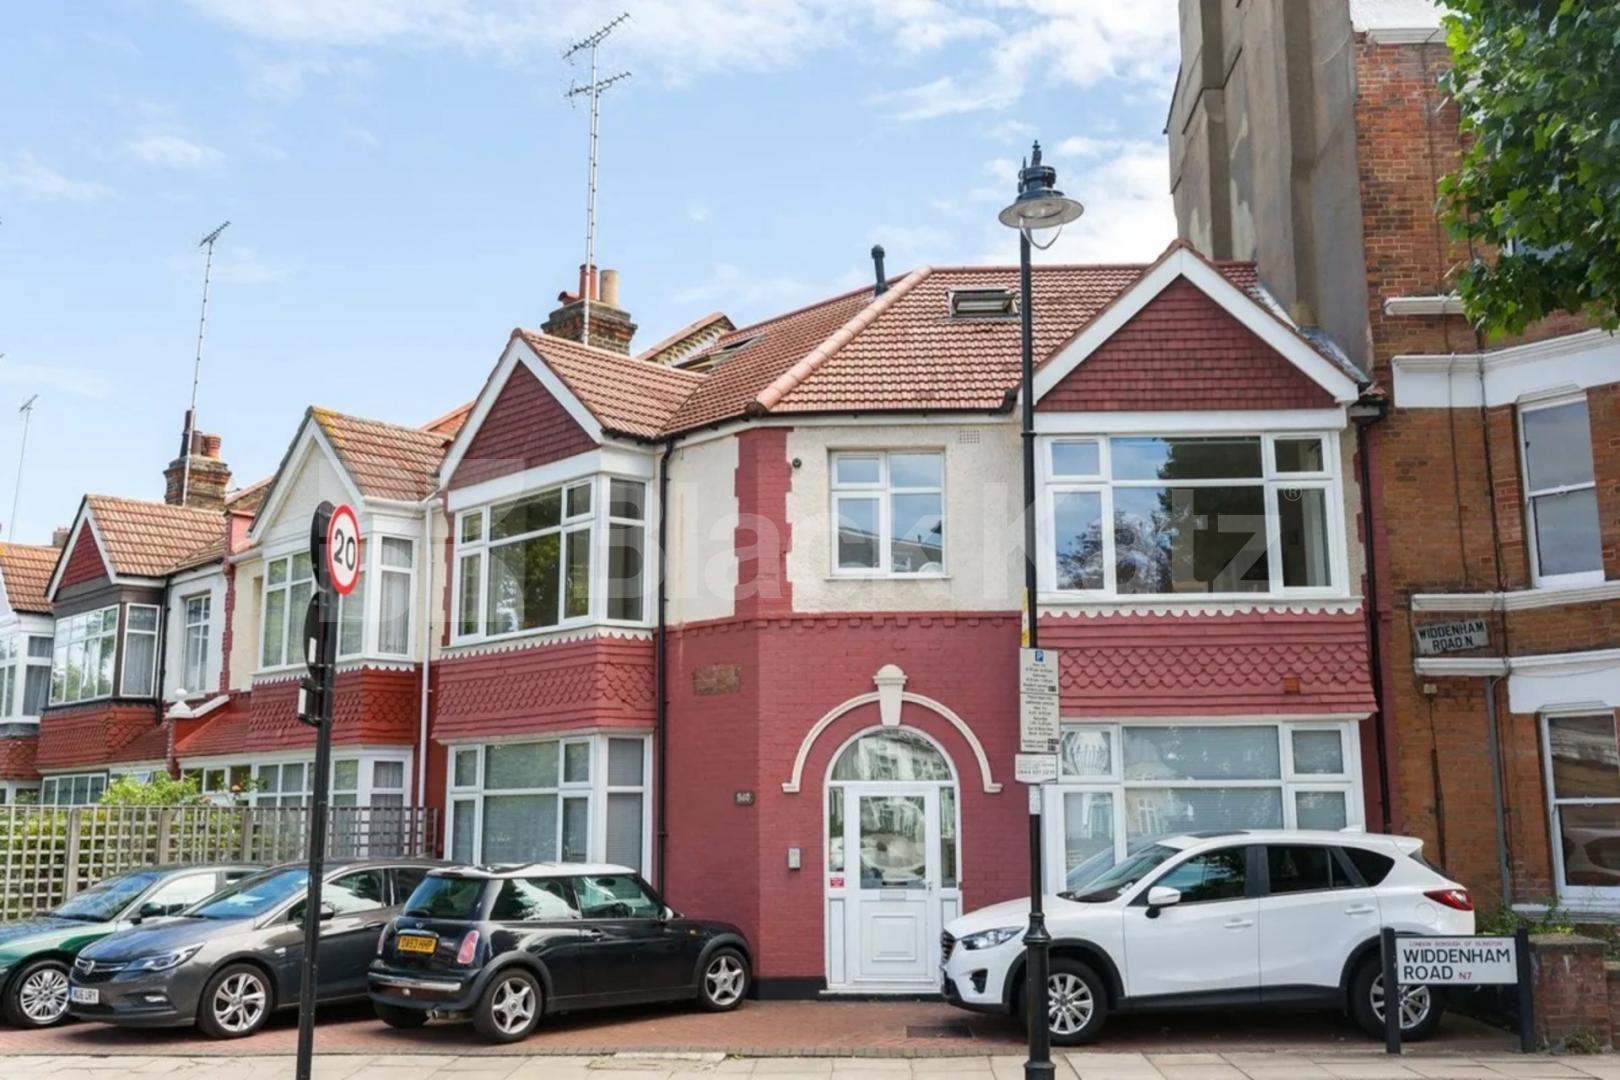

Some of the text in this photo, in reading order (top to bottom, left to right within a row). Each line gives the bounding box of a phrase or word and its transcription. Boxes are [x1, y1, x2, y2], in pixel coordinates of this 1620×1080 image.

[333, 528, 356, 571] 20
[1418, 621, 1485, 640] WIDDENHAM
[1432, 637, 1462, 651] ROAD
[1403, 948, 1510, 964] WIDDENHAM
[1403, 965, 1473, 980] ROAD N7
